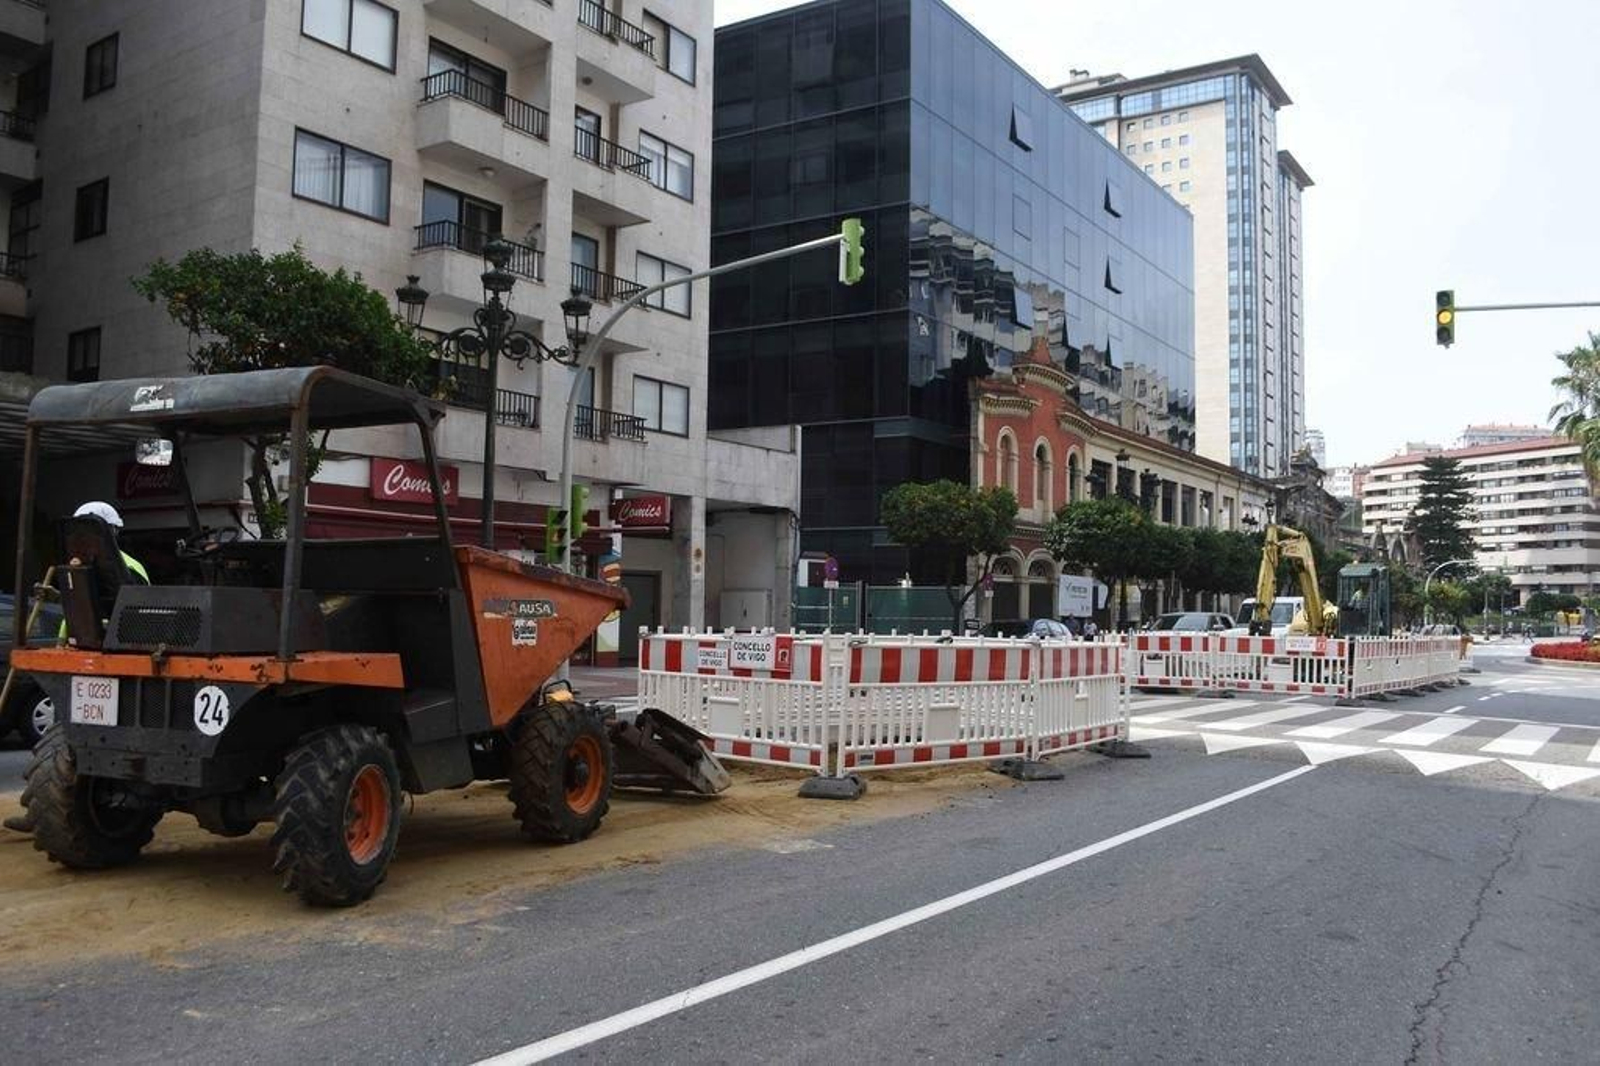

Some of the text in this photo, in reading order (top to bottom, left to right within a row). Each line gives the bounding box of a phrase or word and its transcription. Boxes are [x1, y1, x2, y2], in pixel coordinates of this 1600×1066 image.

[618, 500, 662, 521] Comics
[519, 602, 551, 614] AUSA
[734, 642, 771, 652] CONCELLO
[699, 650, 726, 659] CONCELLO
[737, 652, 766, 661] DE VIGO
[77, 682, 111, 700] E 0233
[199, 693, 224, 726] 24
